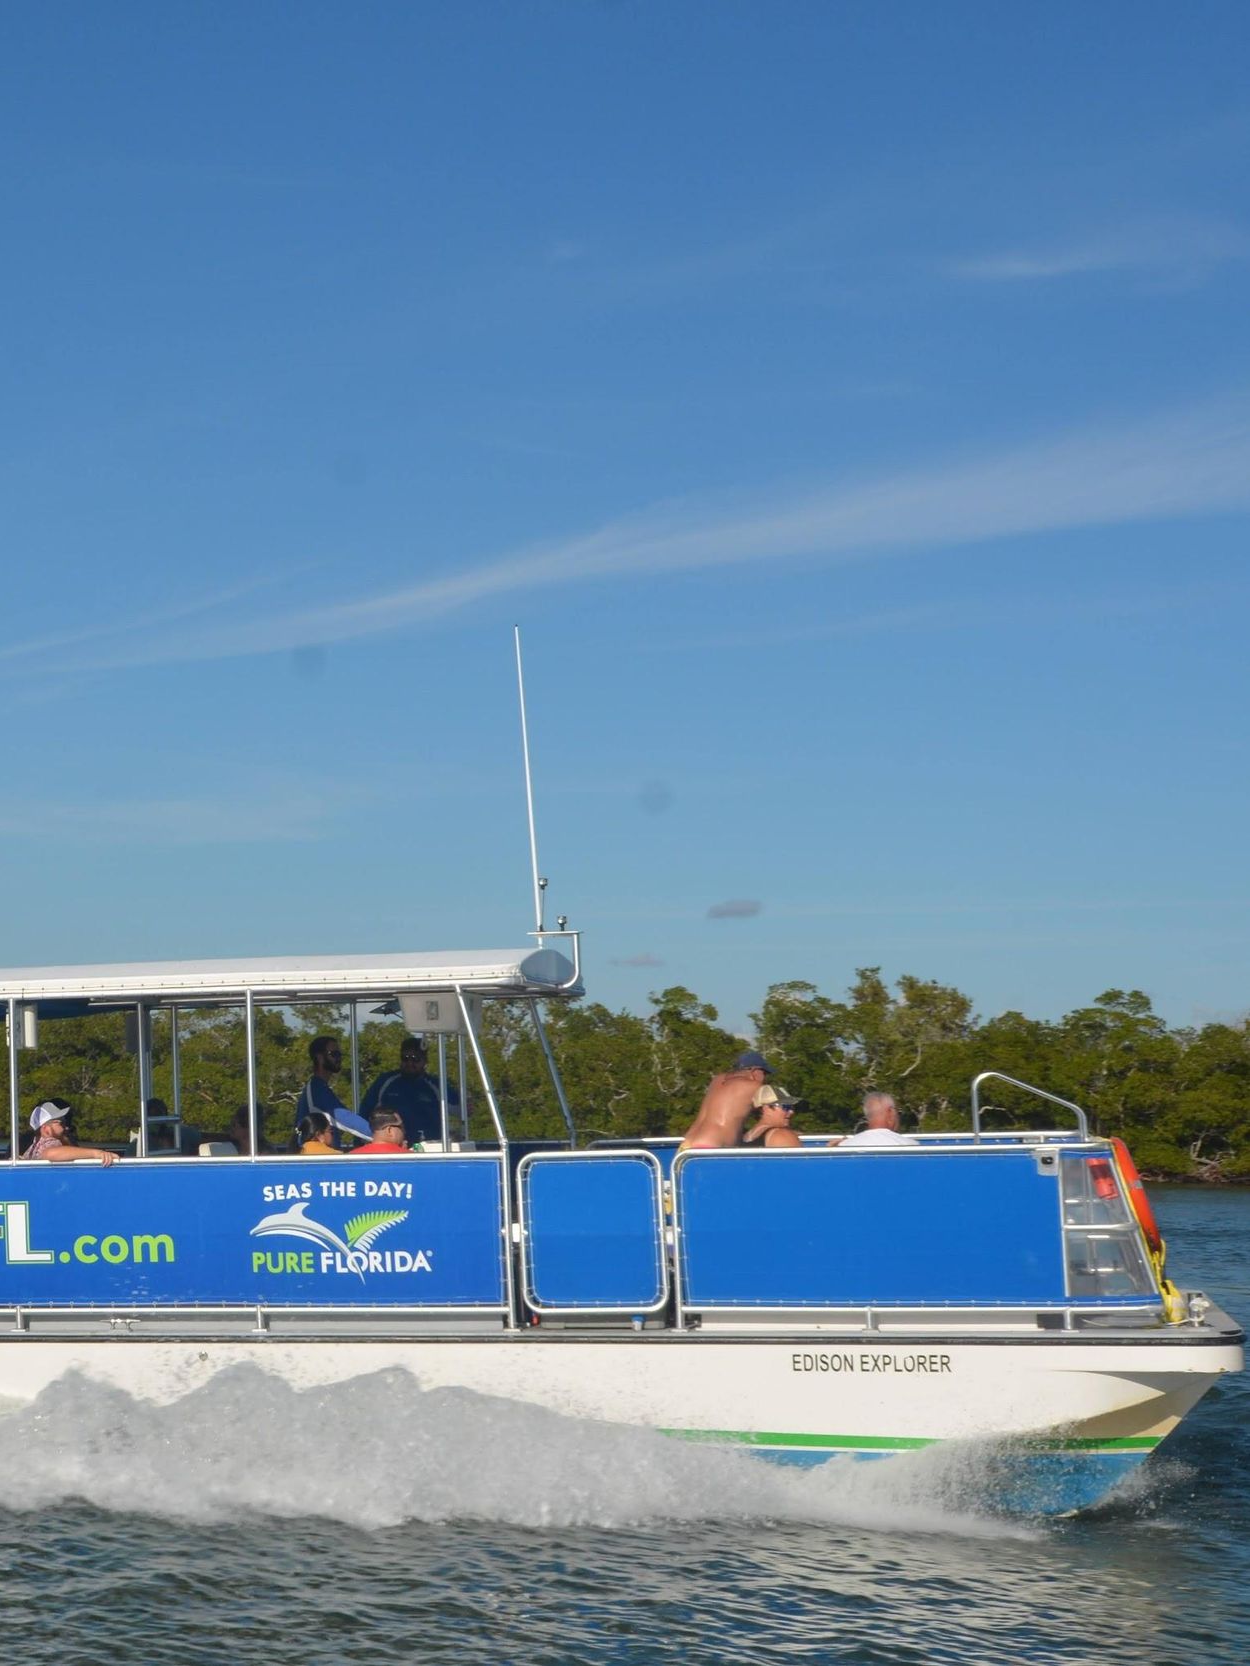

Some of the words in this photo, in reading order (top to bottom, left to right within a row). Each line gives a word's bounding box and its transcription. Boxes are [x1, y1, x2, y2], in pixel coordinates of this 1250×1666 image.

[262, 1182, 312, 1201] SEAS
[320, 1181, 356, 1198] THE
[364, 1181, 413, 1199] DAY!
[252, 1251, 315, 1273] PURE
[320, 1250, 433, 1273] FLORIDA
[792, 1354, 854, 1372] EDISON
[860, 1354, 952, 1373] EXPLORER
